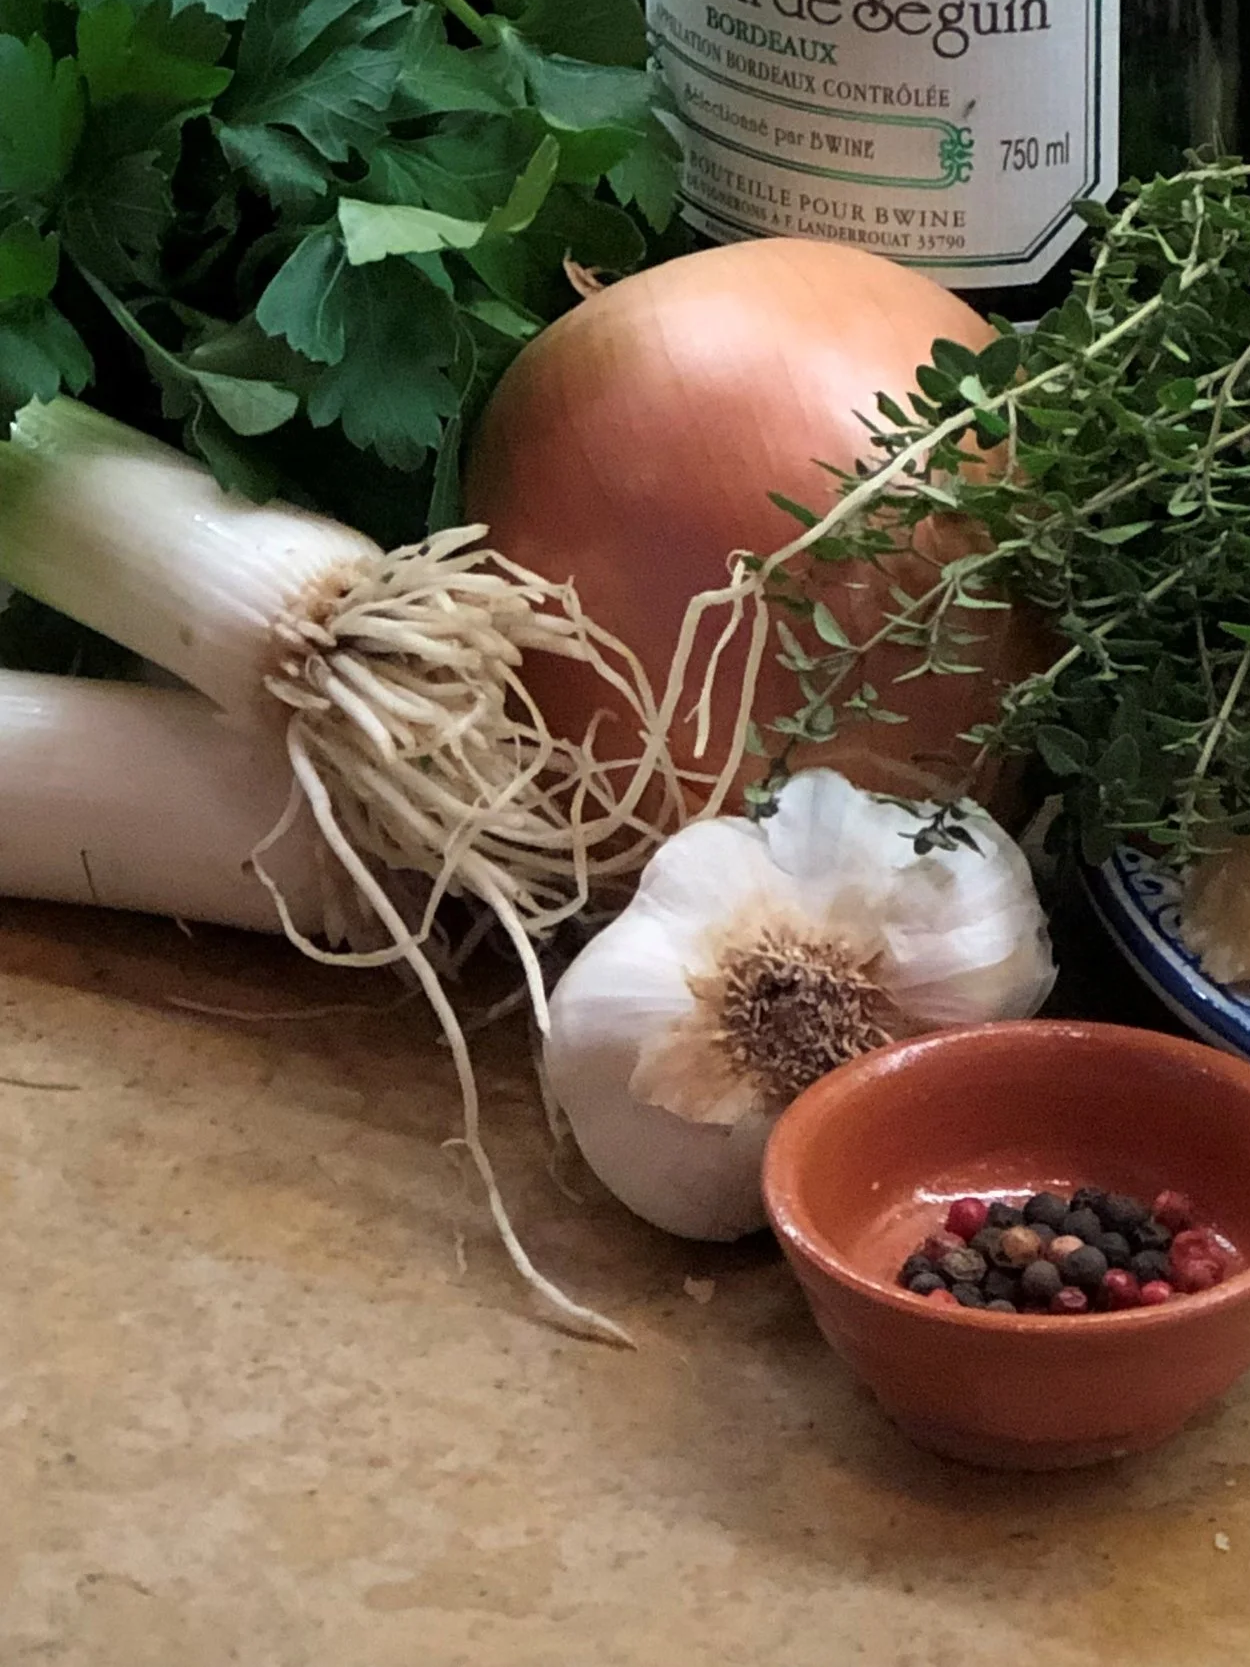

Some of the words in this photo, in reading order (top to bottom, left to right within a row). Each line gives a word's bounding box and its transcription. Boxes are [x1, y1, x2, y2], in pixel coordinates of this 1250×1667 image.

[705, 5, 839, 67] BORDEAUX
[726, 49, 816, 95] BORDEAUX
[823, 77, 951, 109] CONTRÔLÉE
[774, 126, 805, 147] par
[809, 129, 876, 160] BWINE
[1000, 140, 1040, 172] 750
[1045, 132, 1071, 167] ml
[689, 149, 792, 207] BOUTEILLE
[799, 193, 866, 223] POUR
[875, 206, 967, 229] BWINE
[798, 217, 911, 248] LANDERROUAT
[917, 235, 966, 250] 33790
